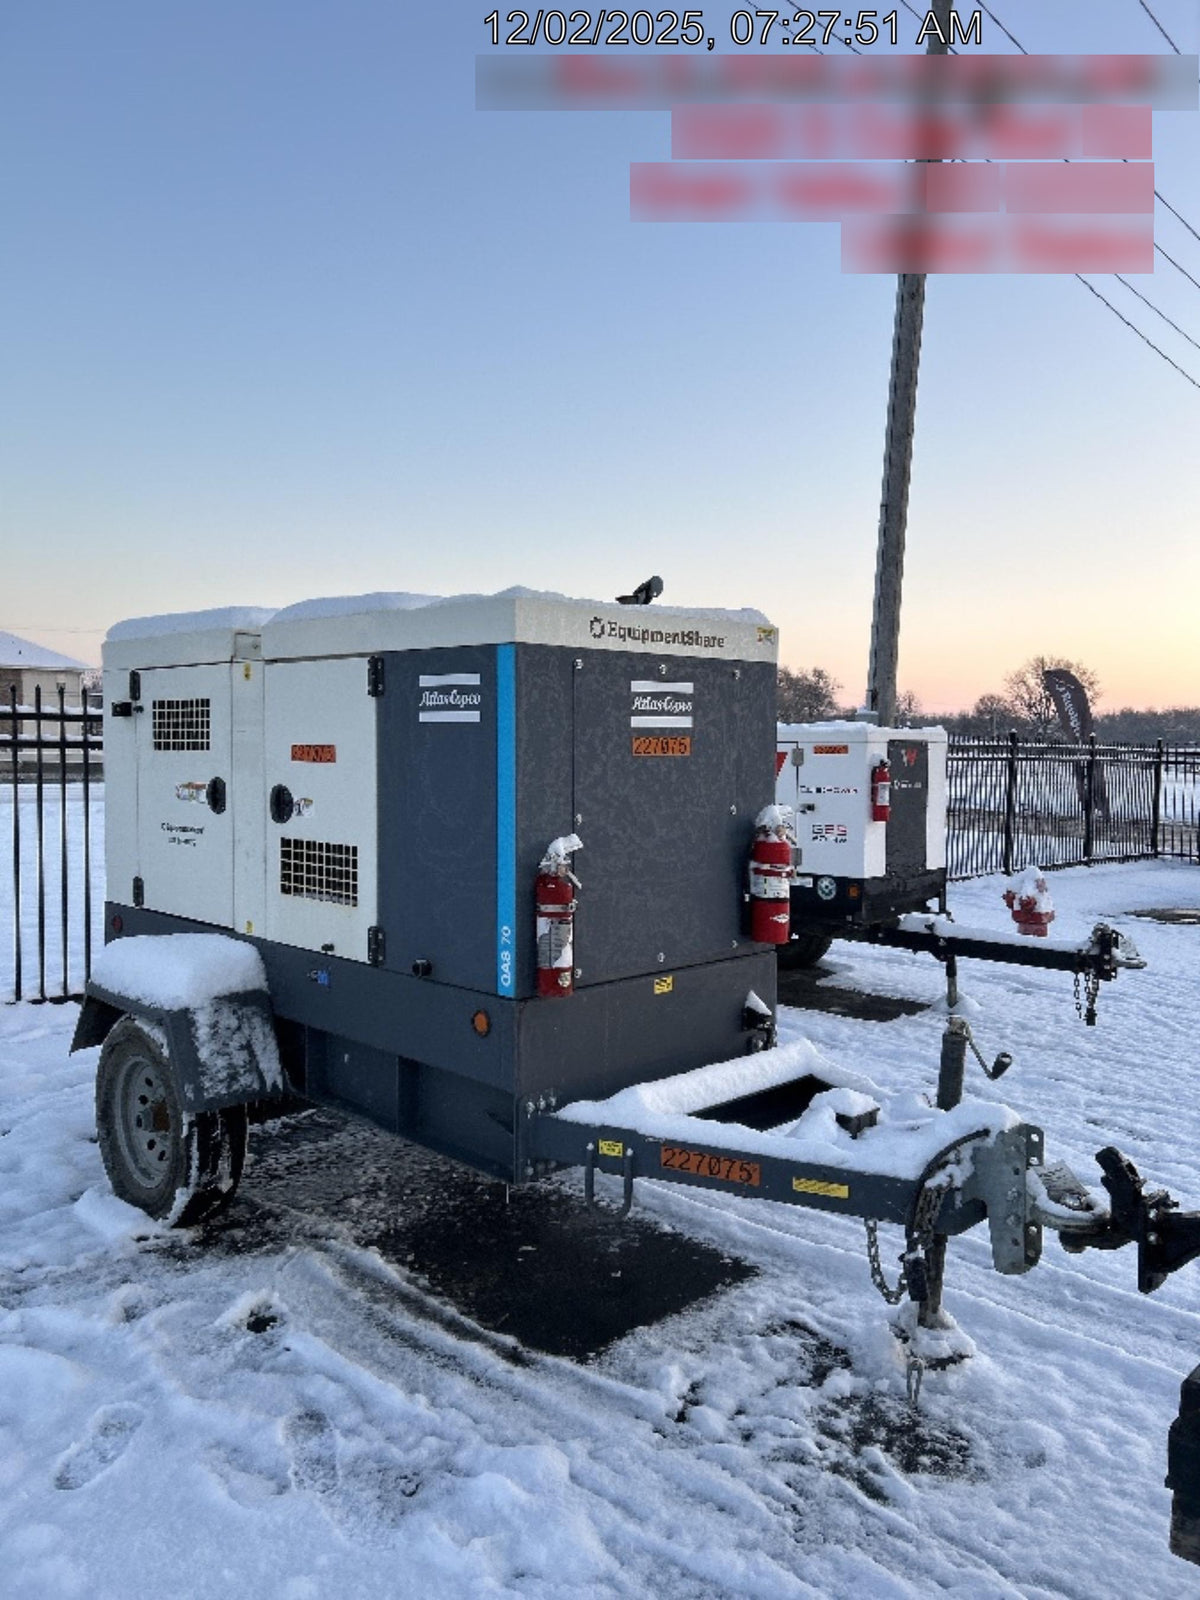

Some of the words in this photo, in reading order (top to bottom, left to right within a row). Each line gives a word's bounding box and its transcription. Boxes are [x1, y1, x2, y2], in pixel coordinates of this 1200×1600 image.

[607, 621, 725, 648] EquipmentShare
[634, 737, 687, 754] 227075
[500, 925, 512, 945] 70
[662, 1148, 753, 1184] 227075
